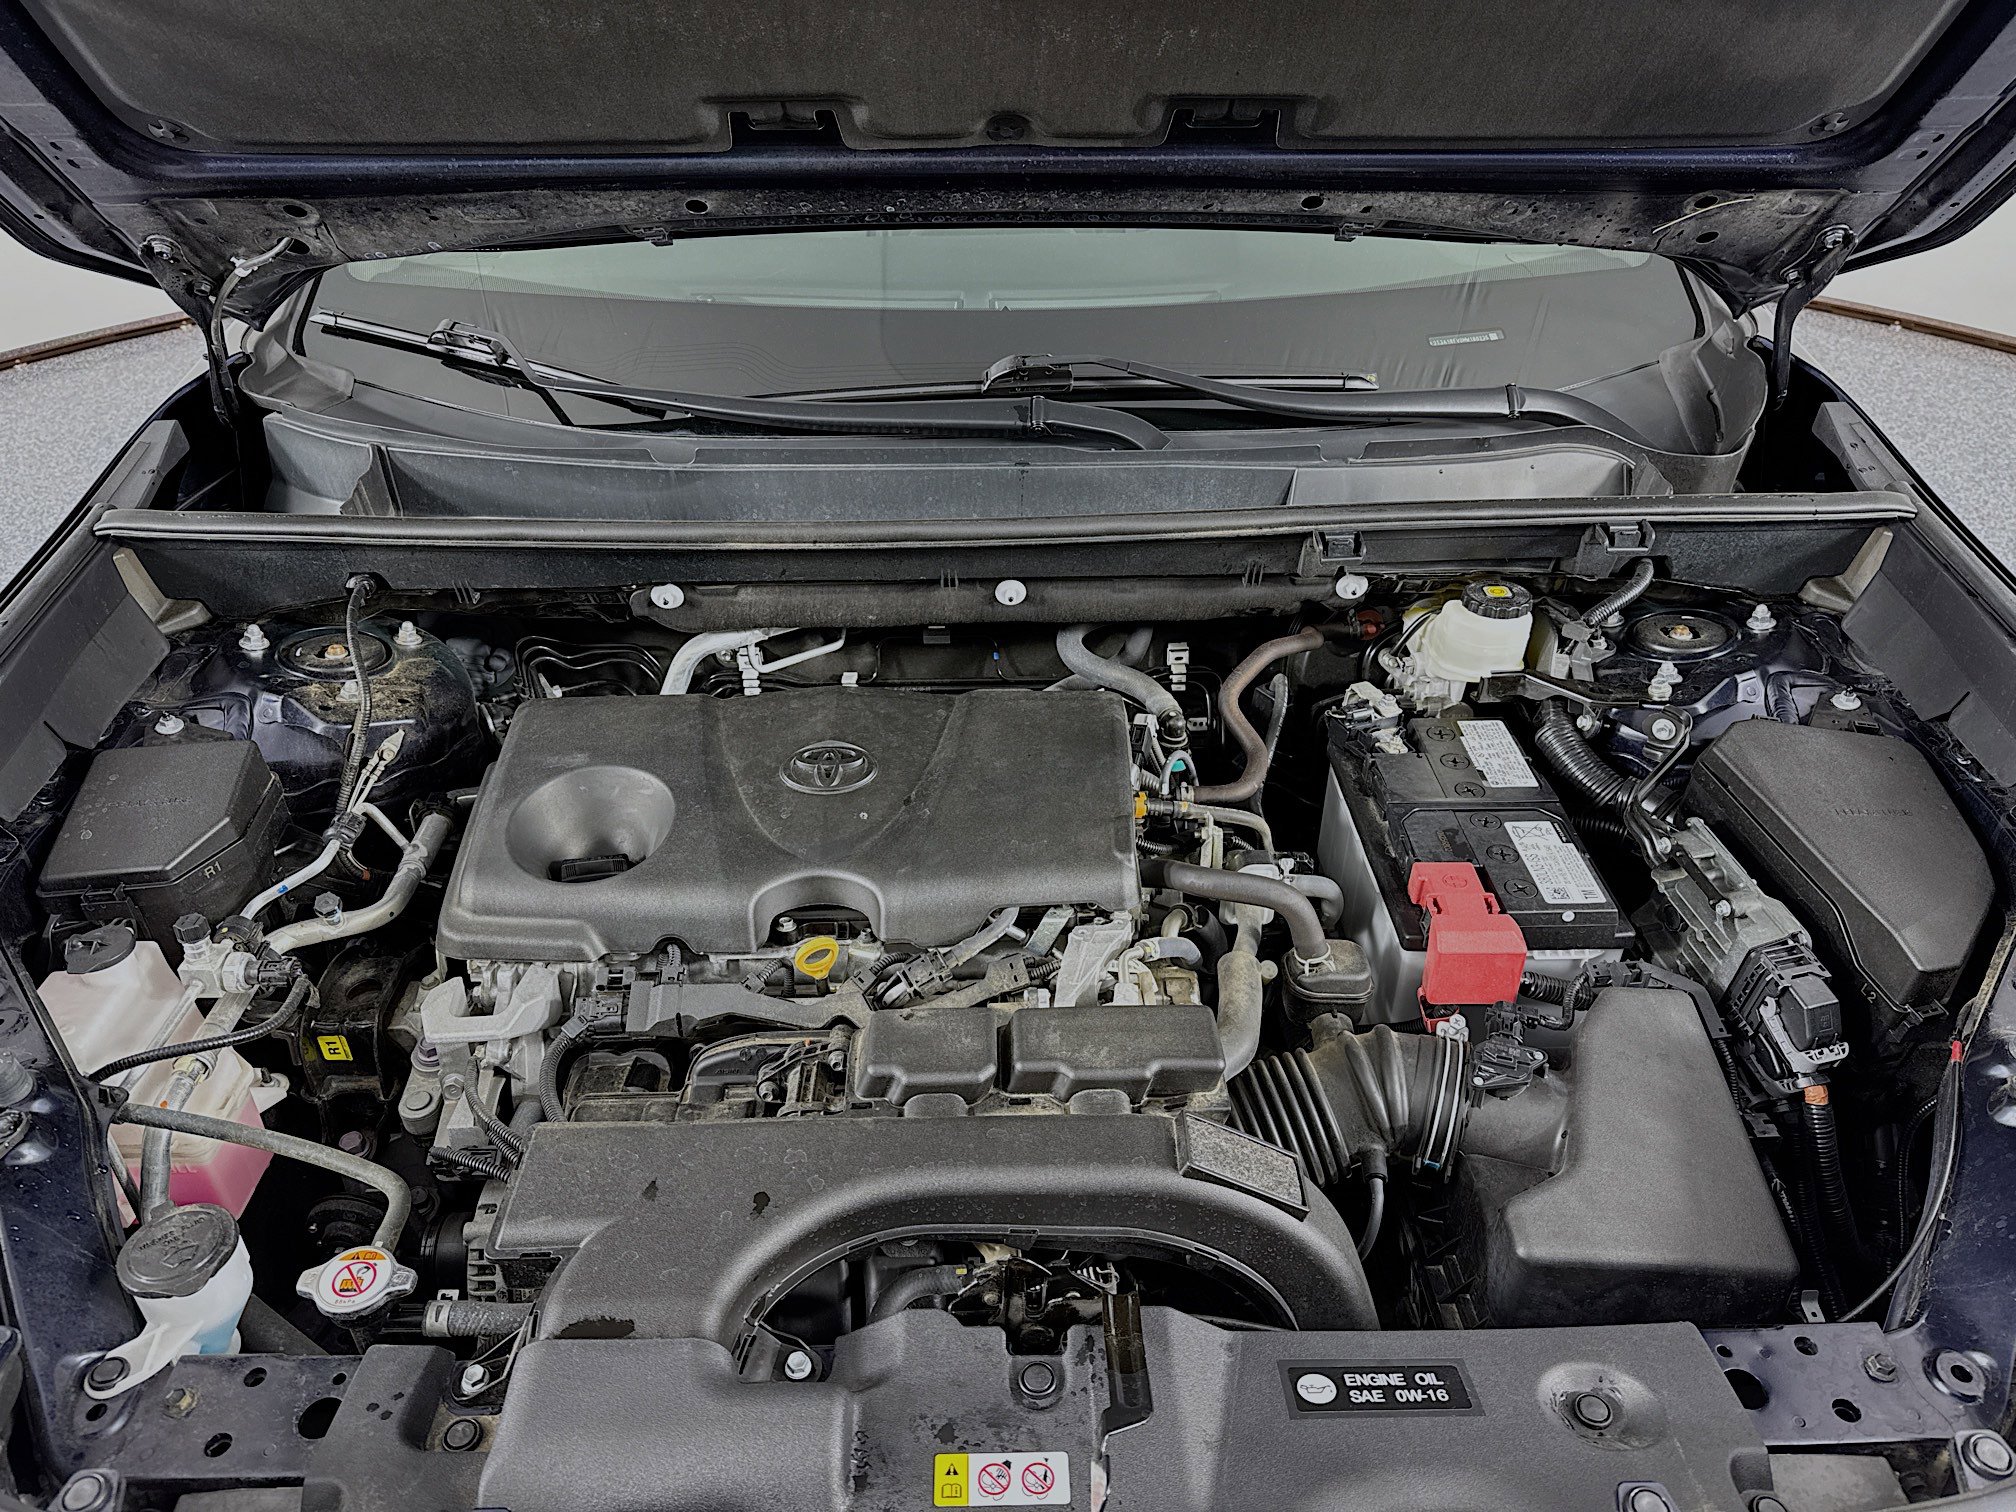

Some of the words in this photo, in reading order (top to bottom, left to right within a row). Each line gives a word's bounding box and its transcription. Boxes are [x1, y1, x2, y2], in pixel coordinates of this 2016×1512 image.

[204, 861, 221, 878] R1
[1861, 983, 1876, 1003] L2
[325, 1041, 341, 1055] R1
[1343, 1373, 1407, 1386] ENGINE
[1414, 1373, 1444, 1386] OIL
[1349, 1389, 1386, 1403] SAE
[1395, 1389, 1449, 1402] 0W-16
